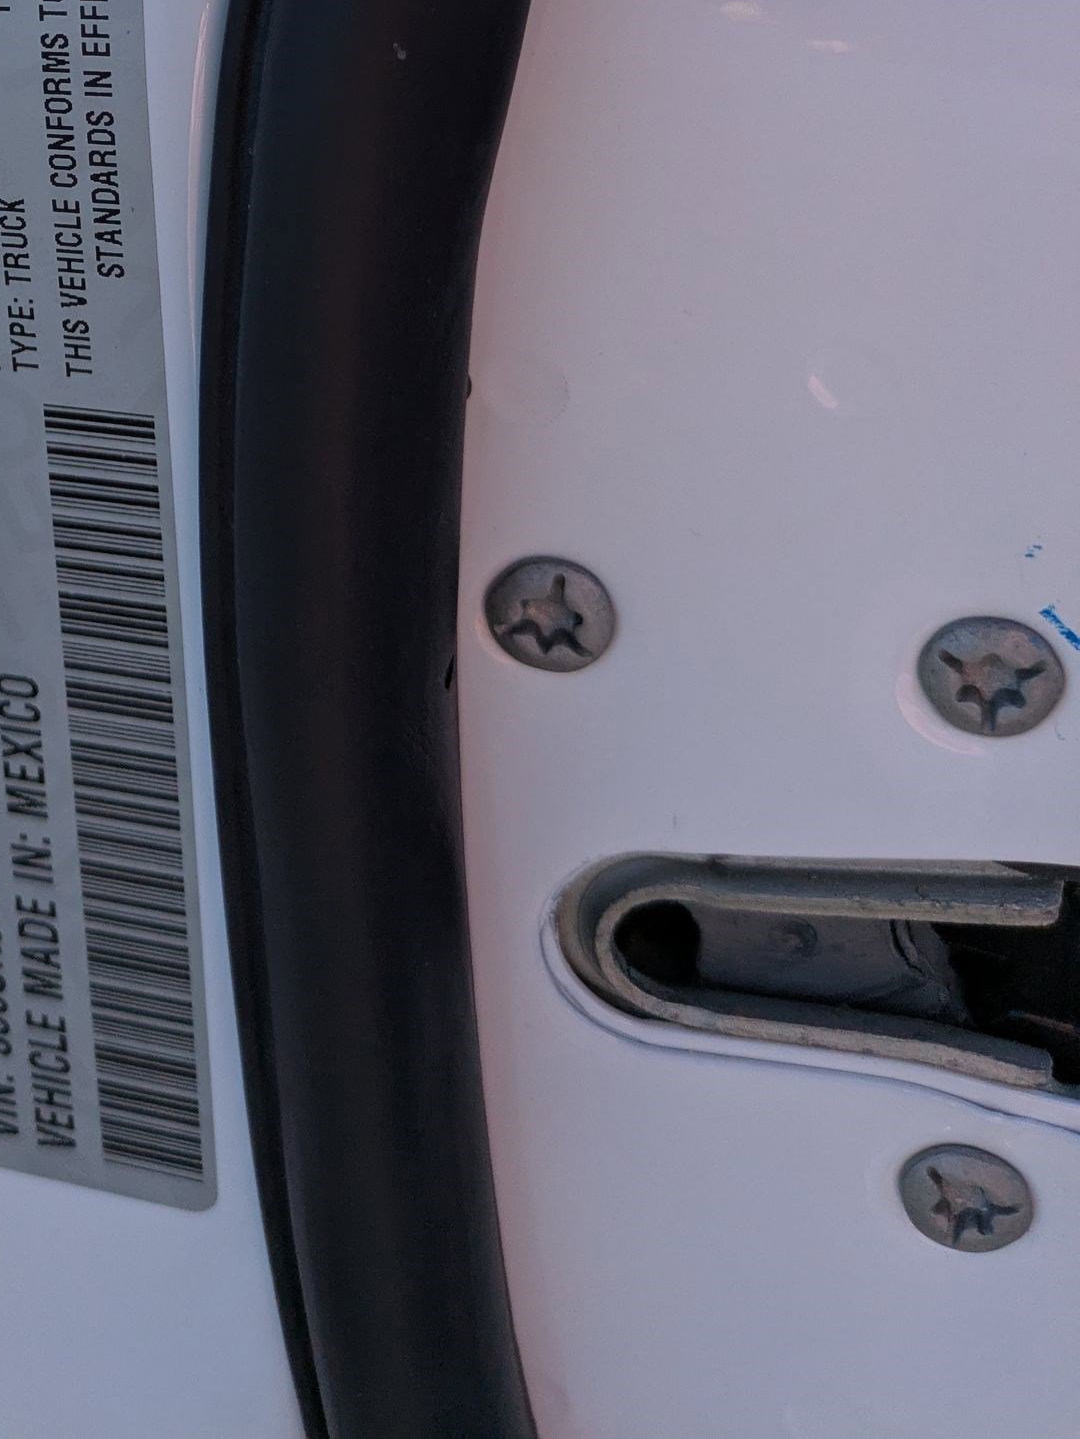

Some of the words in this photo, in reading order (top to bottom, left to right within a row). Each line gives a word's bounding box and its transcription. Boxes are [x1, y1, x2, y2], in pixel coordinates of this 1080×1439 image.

[41, 34, 77, 187] CONFORMS
[83, 71, 112, 97] IN
[86, 111, 124, 278] STANDARDS
[52, 200, 87, 307] VEHICLE
[8, 298, 38, 372] TYPE:
[63, 319, 92, 377] THIS
[11, 834, 53, 884] IN:
[16, 897, 63, 1000] MADE
[26, 1011, 76, 1148] VEHICLE
